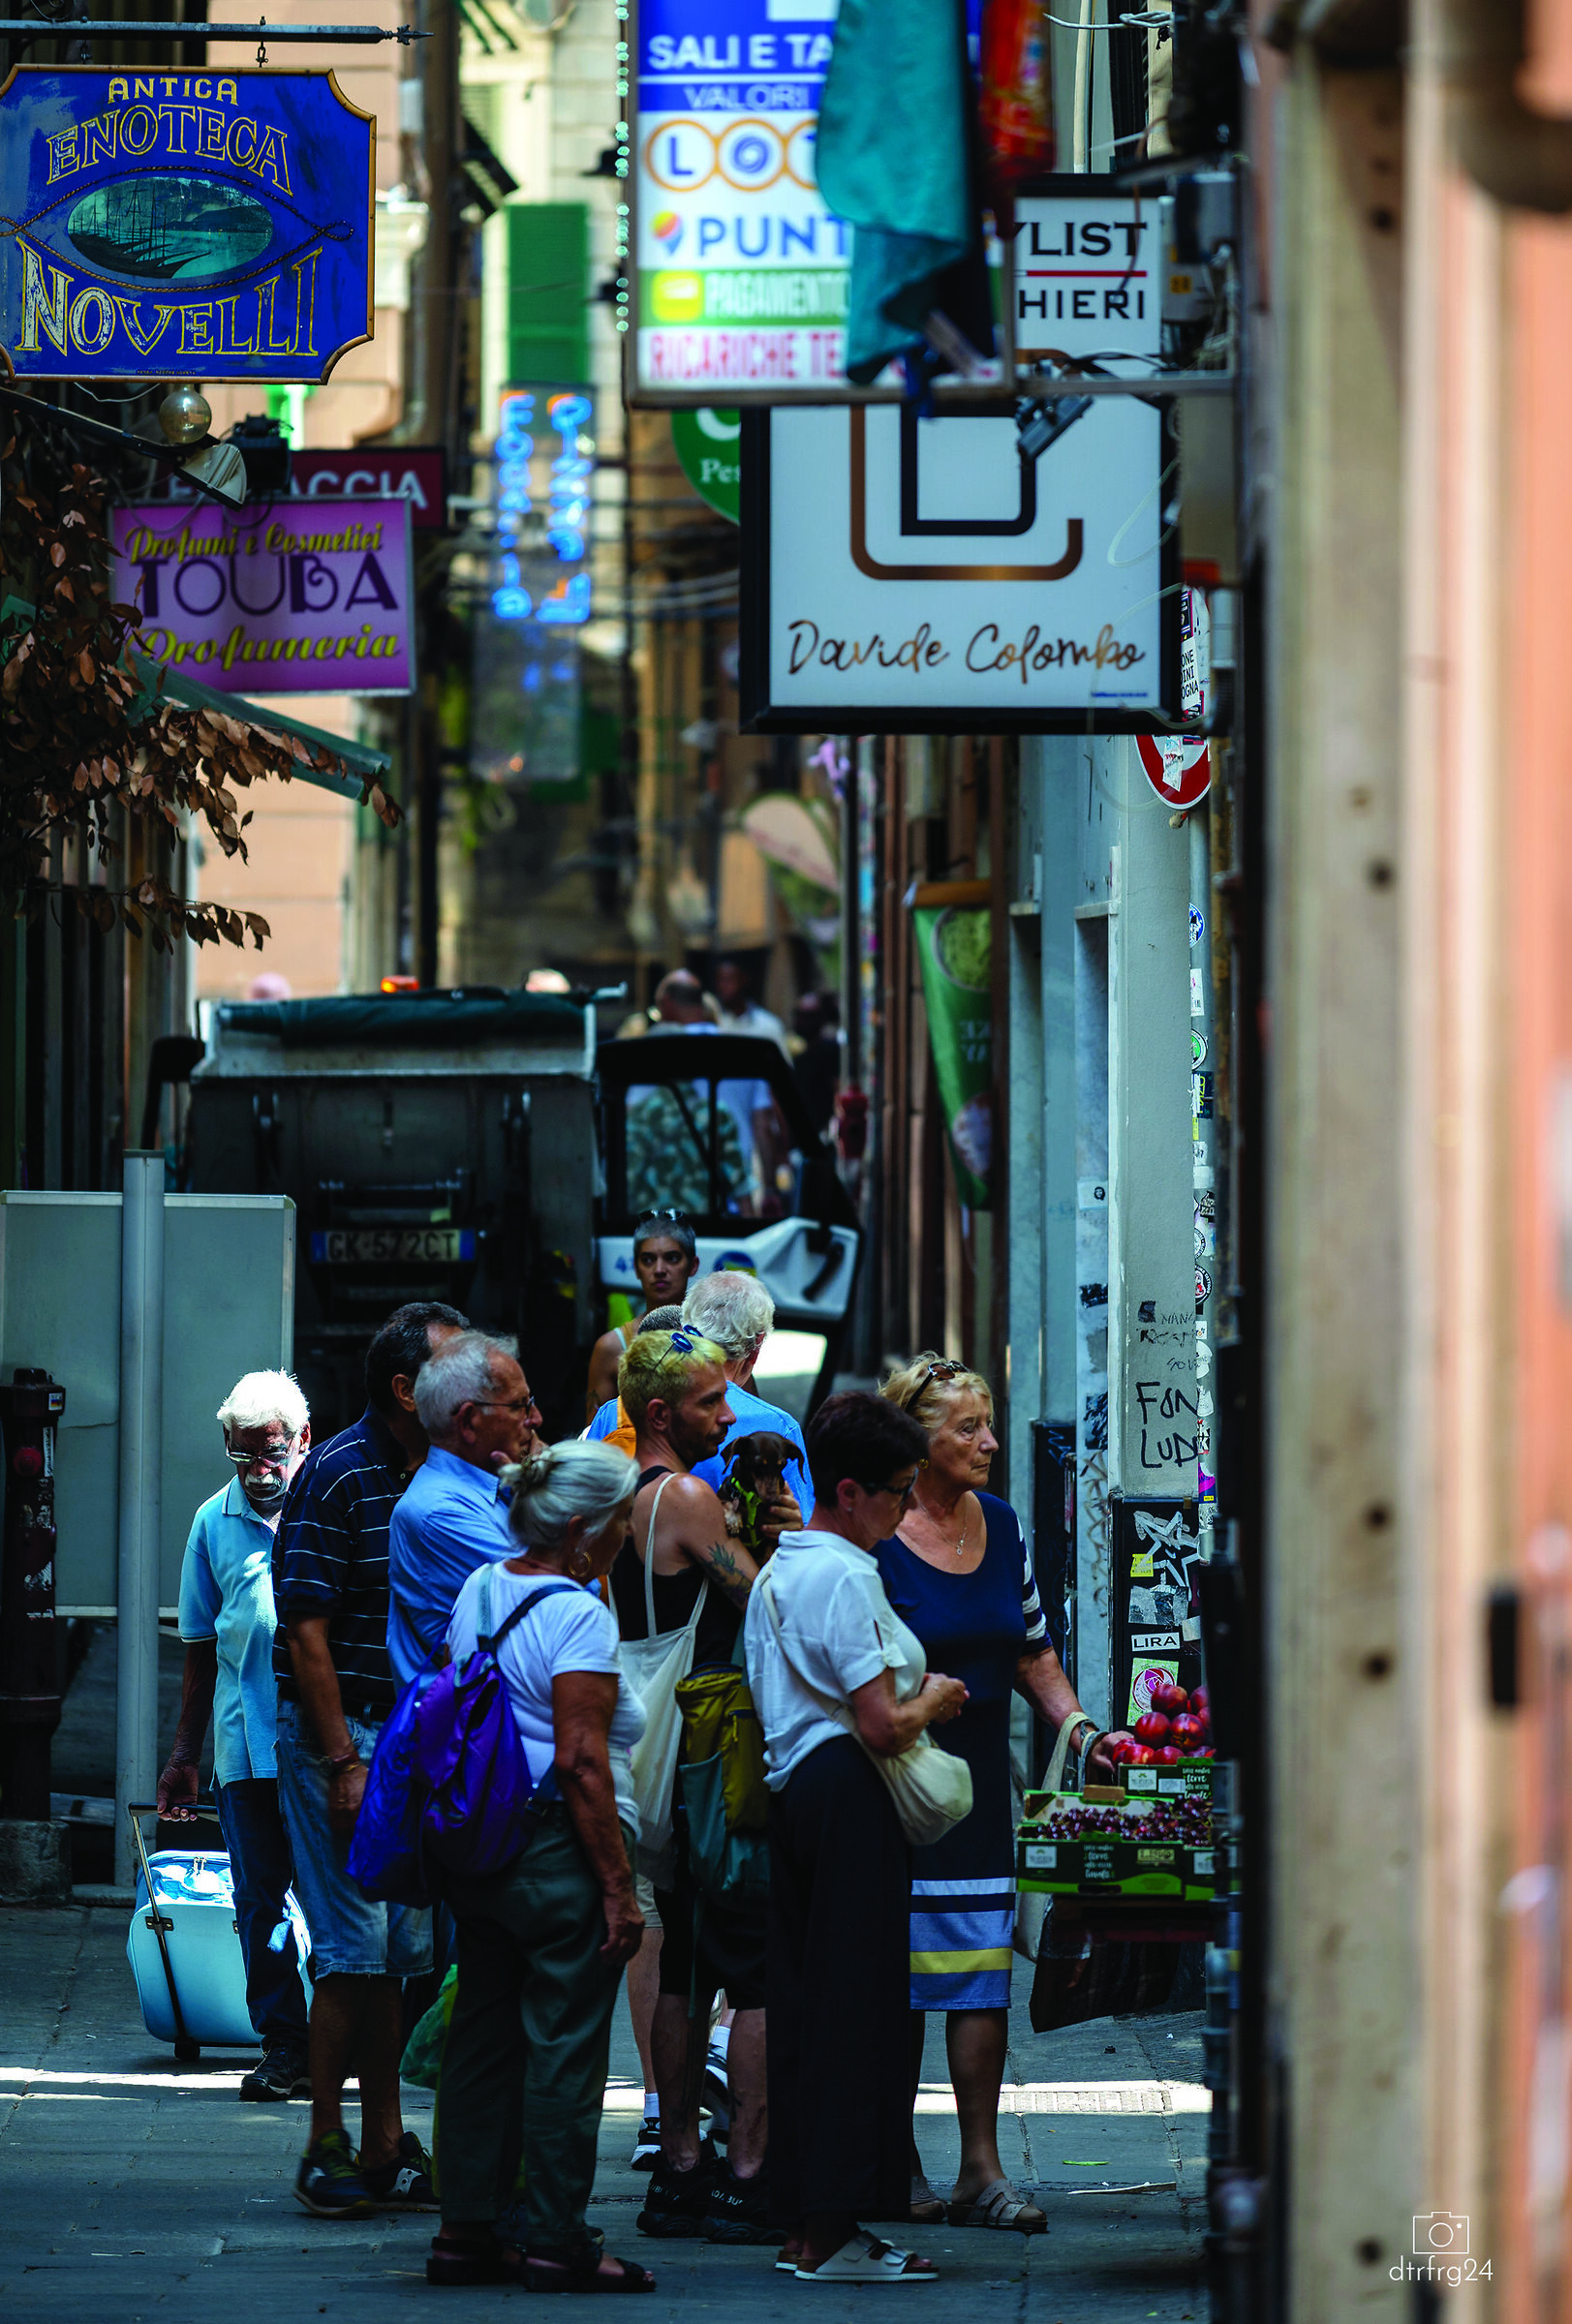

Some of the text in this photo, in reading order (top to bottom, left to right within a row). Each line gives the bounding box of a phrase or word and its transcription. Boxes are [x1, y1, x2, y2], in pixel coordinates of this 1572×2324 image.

[648, 34, 739, 70] SALI
[749, 34, 776, 69] E
[108, 77, 238, 105] ANTICA
[684, 84, 809, 111] VALORI
[46, 105, 293, 198] ENOTECA
[15, 236, 323, 356] NOVELLI
[1018, 290, 1145, 320] HIERI
[125, 525, 238, 565] Profumi
[265, 522, 385, 554] Cosmetici
[130, 552, 398, 618] TOUBA
[126, 625, 400, 671] Profumeria
[787, 620, 1146, 685] Davide Colombo
[1133, 1636, 1178, 1648] LIRA
